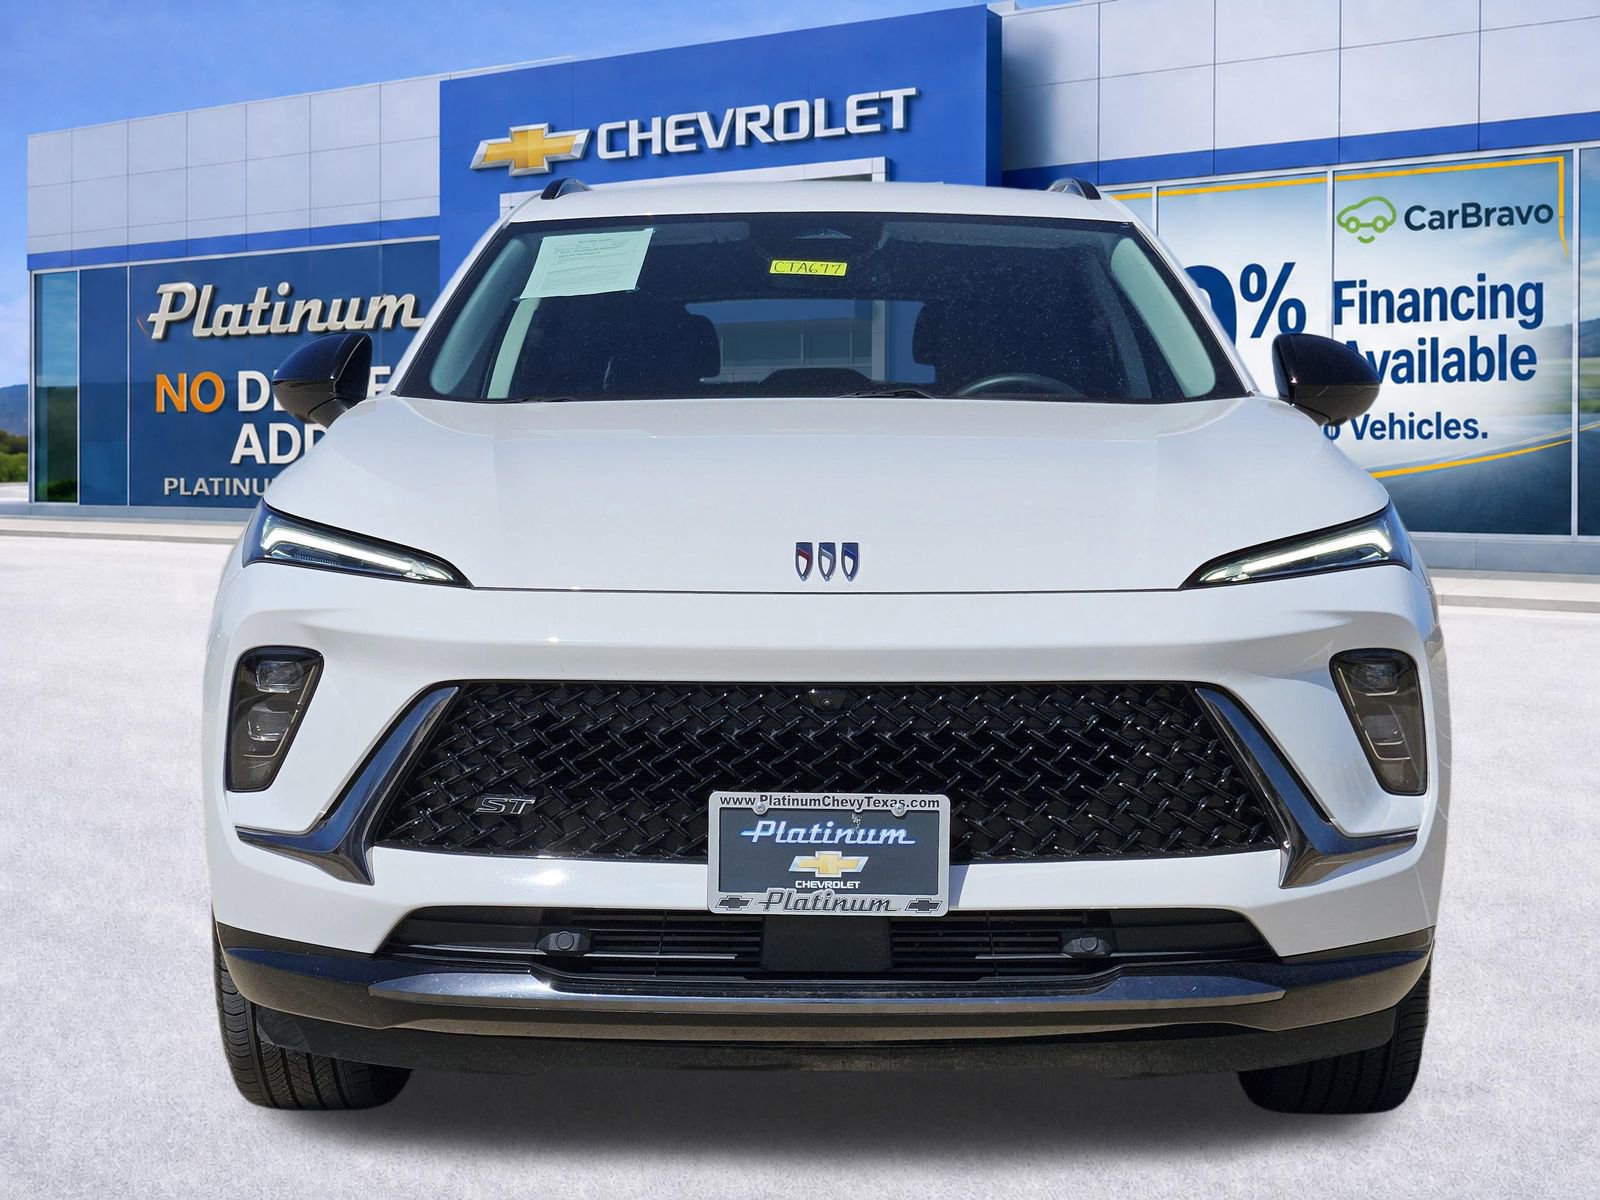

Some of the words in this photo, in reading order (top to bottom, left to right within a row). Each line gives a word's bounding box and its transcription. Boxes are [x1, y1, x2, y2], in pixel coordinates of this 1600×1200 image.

[597, 86, 919, 160] CHEVROLET
[1403, 201, 1554, 232] CarBravo
[774, 261, 841, 274] CTA677
[147, 281, 424, 341] Platinum
[1333, 273, 1544, 331] Financing
[1346, 334, 1537, 385] vailable
[155, 371, 226, 414] NO
[1350, 413, 1489, 441] Vehicles.
[163, 476, 275, 497] PLATINU
[475, 797, 536, 815] ST
[719, 794, 940, 810] wwwPlatinumChevyTexas.com
[740, 820, 916, 845] Platinum
[795, 880, 861, 890] CHEVROLET
[757, 888, 900, 912] Platinum
